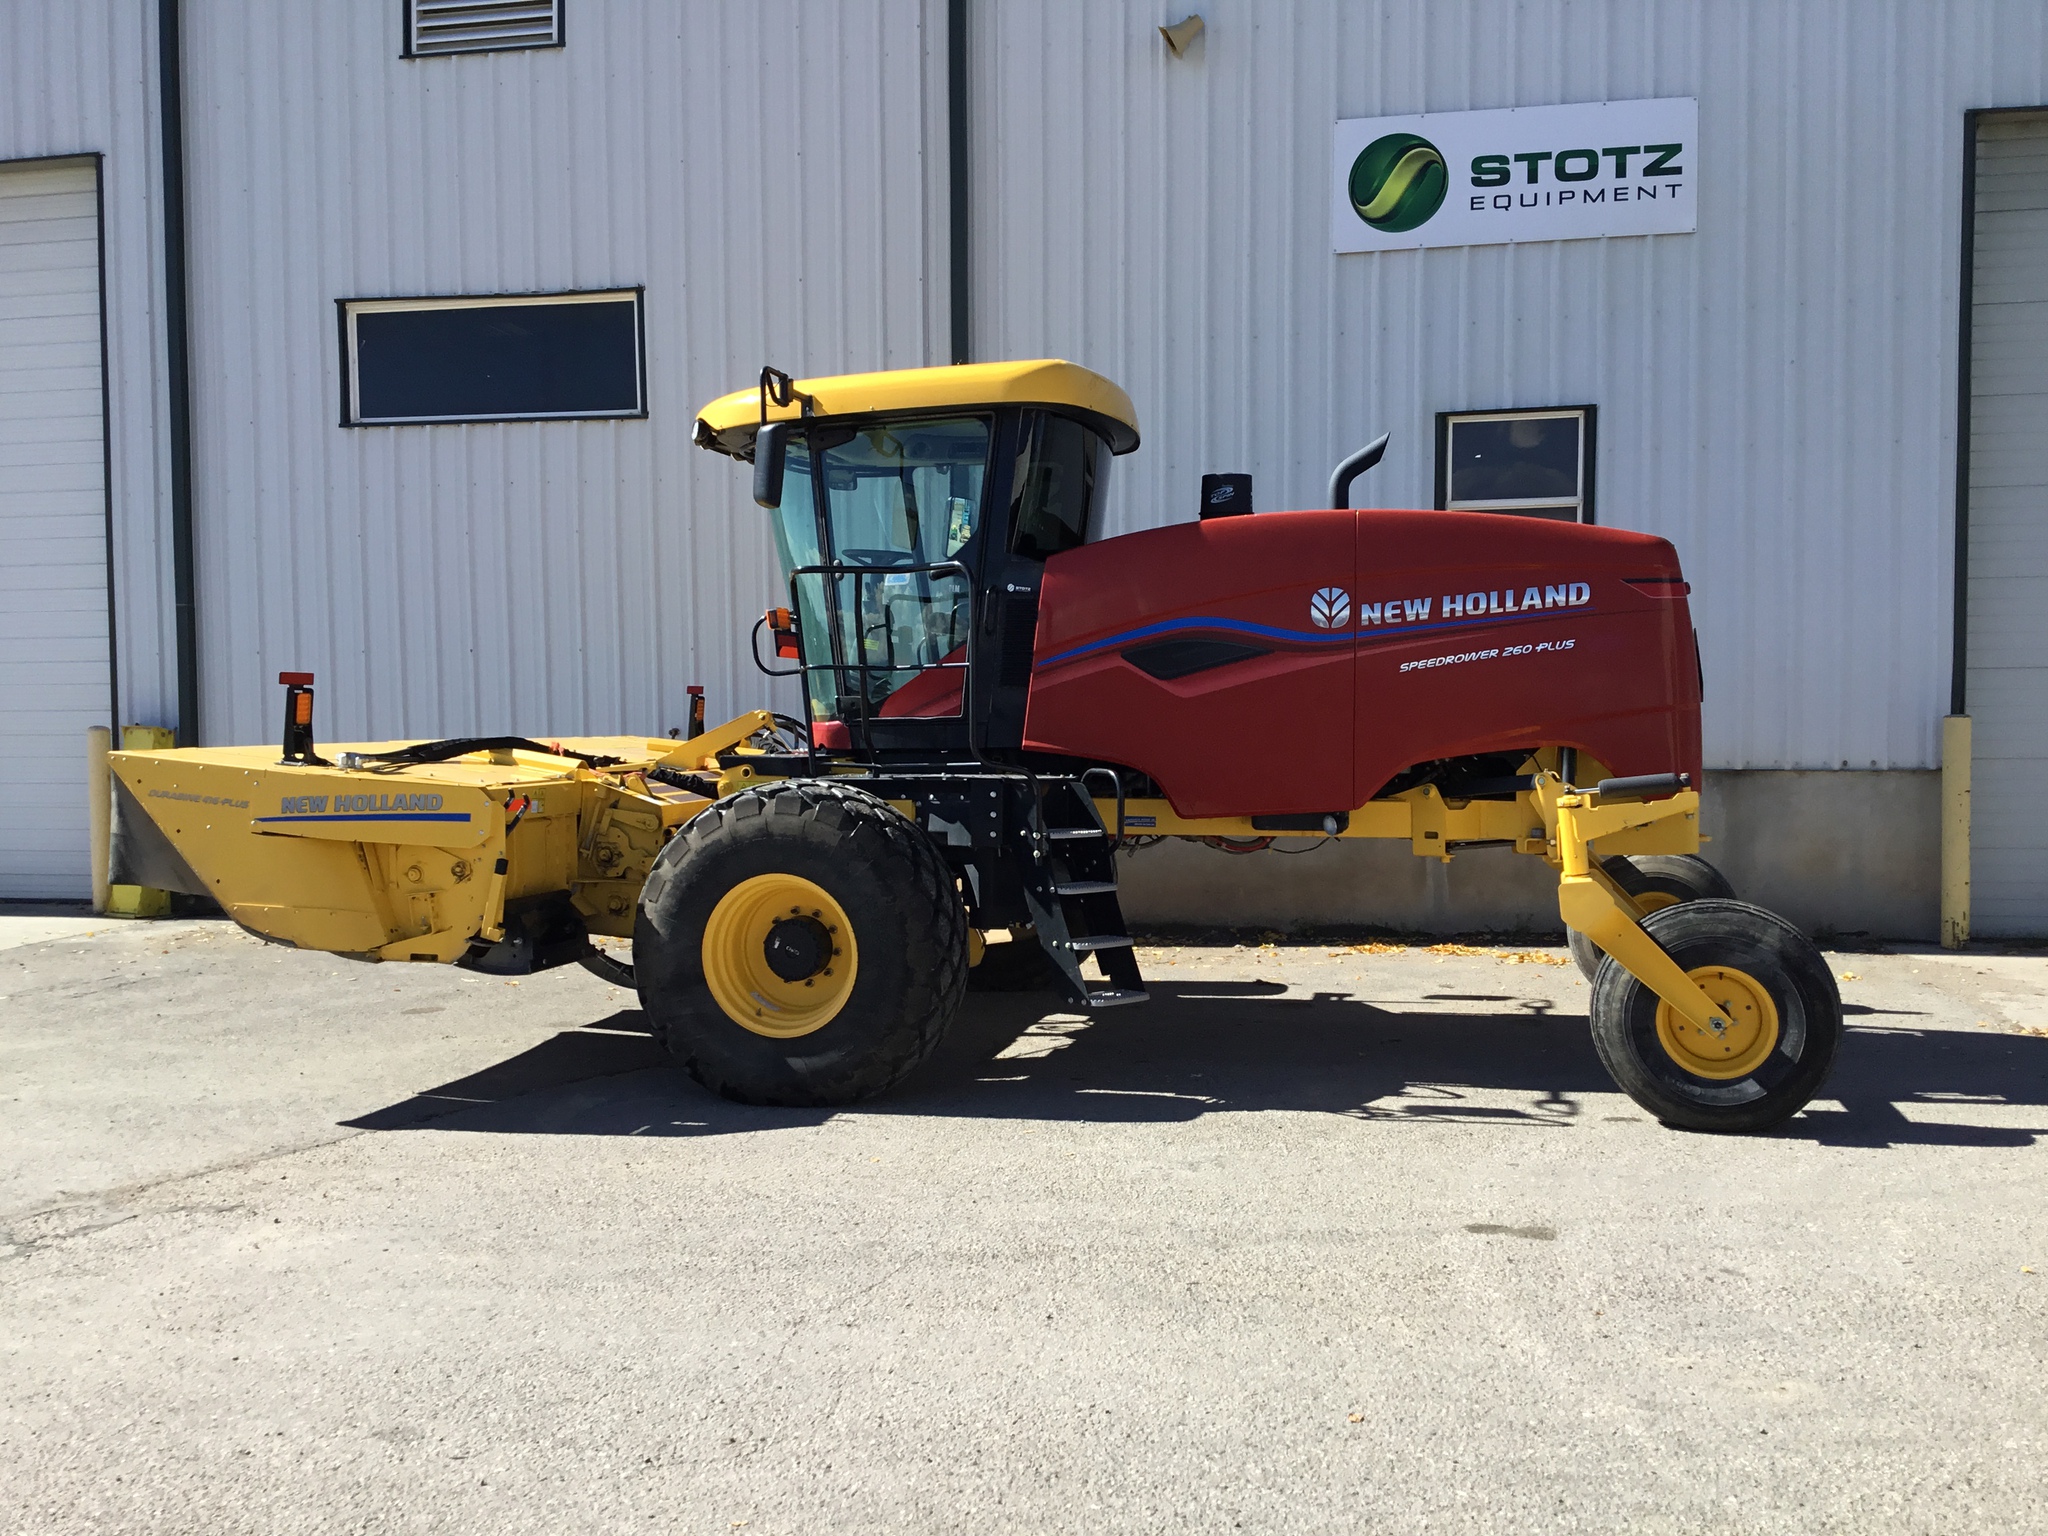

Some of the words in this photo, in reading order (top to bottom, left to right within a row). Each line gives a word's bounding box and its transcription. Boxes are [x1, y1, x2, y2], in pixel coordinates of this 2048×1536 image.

[1470, 143, 1683, 188] STOTZ
[1470, 183, 1683, 211] EQUIPMENT
[1361, 597, 1432, 626] NEW
[1442, 582, 1591, 618] HOLLAND
[1399, 649, 1499, 673] SPEEDROWER
[1502, 644, 1533, 657] 260
[281, 795, 329, 814] NEW
[334, 793, 443, 813] HOLLAND
